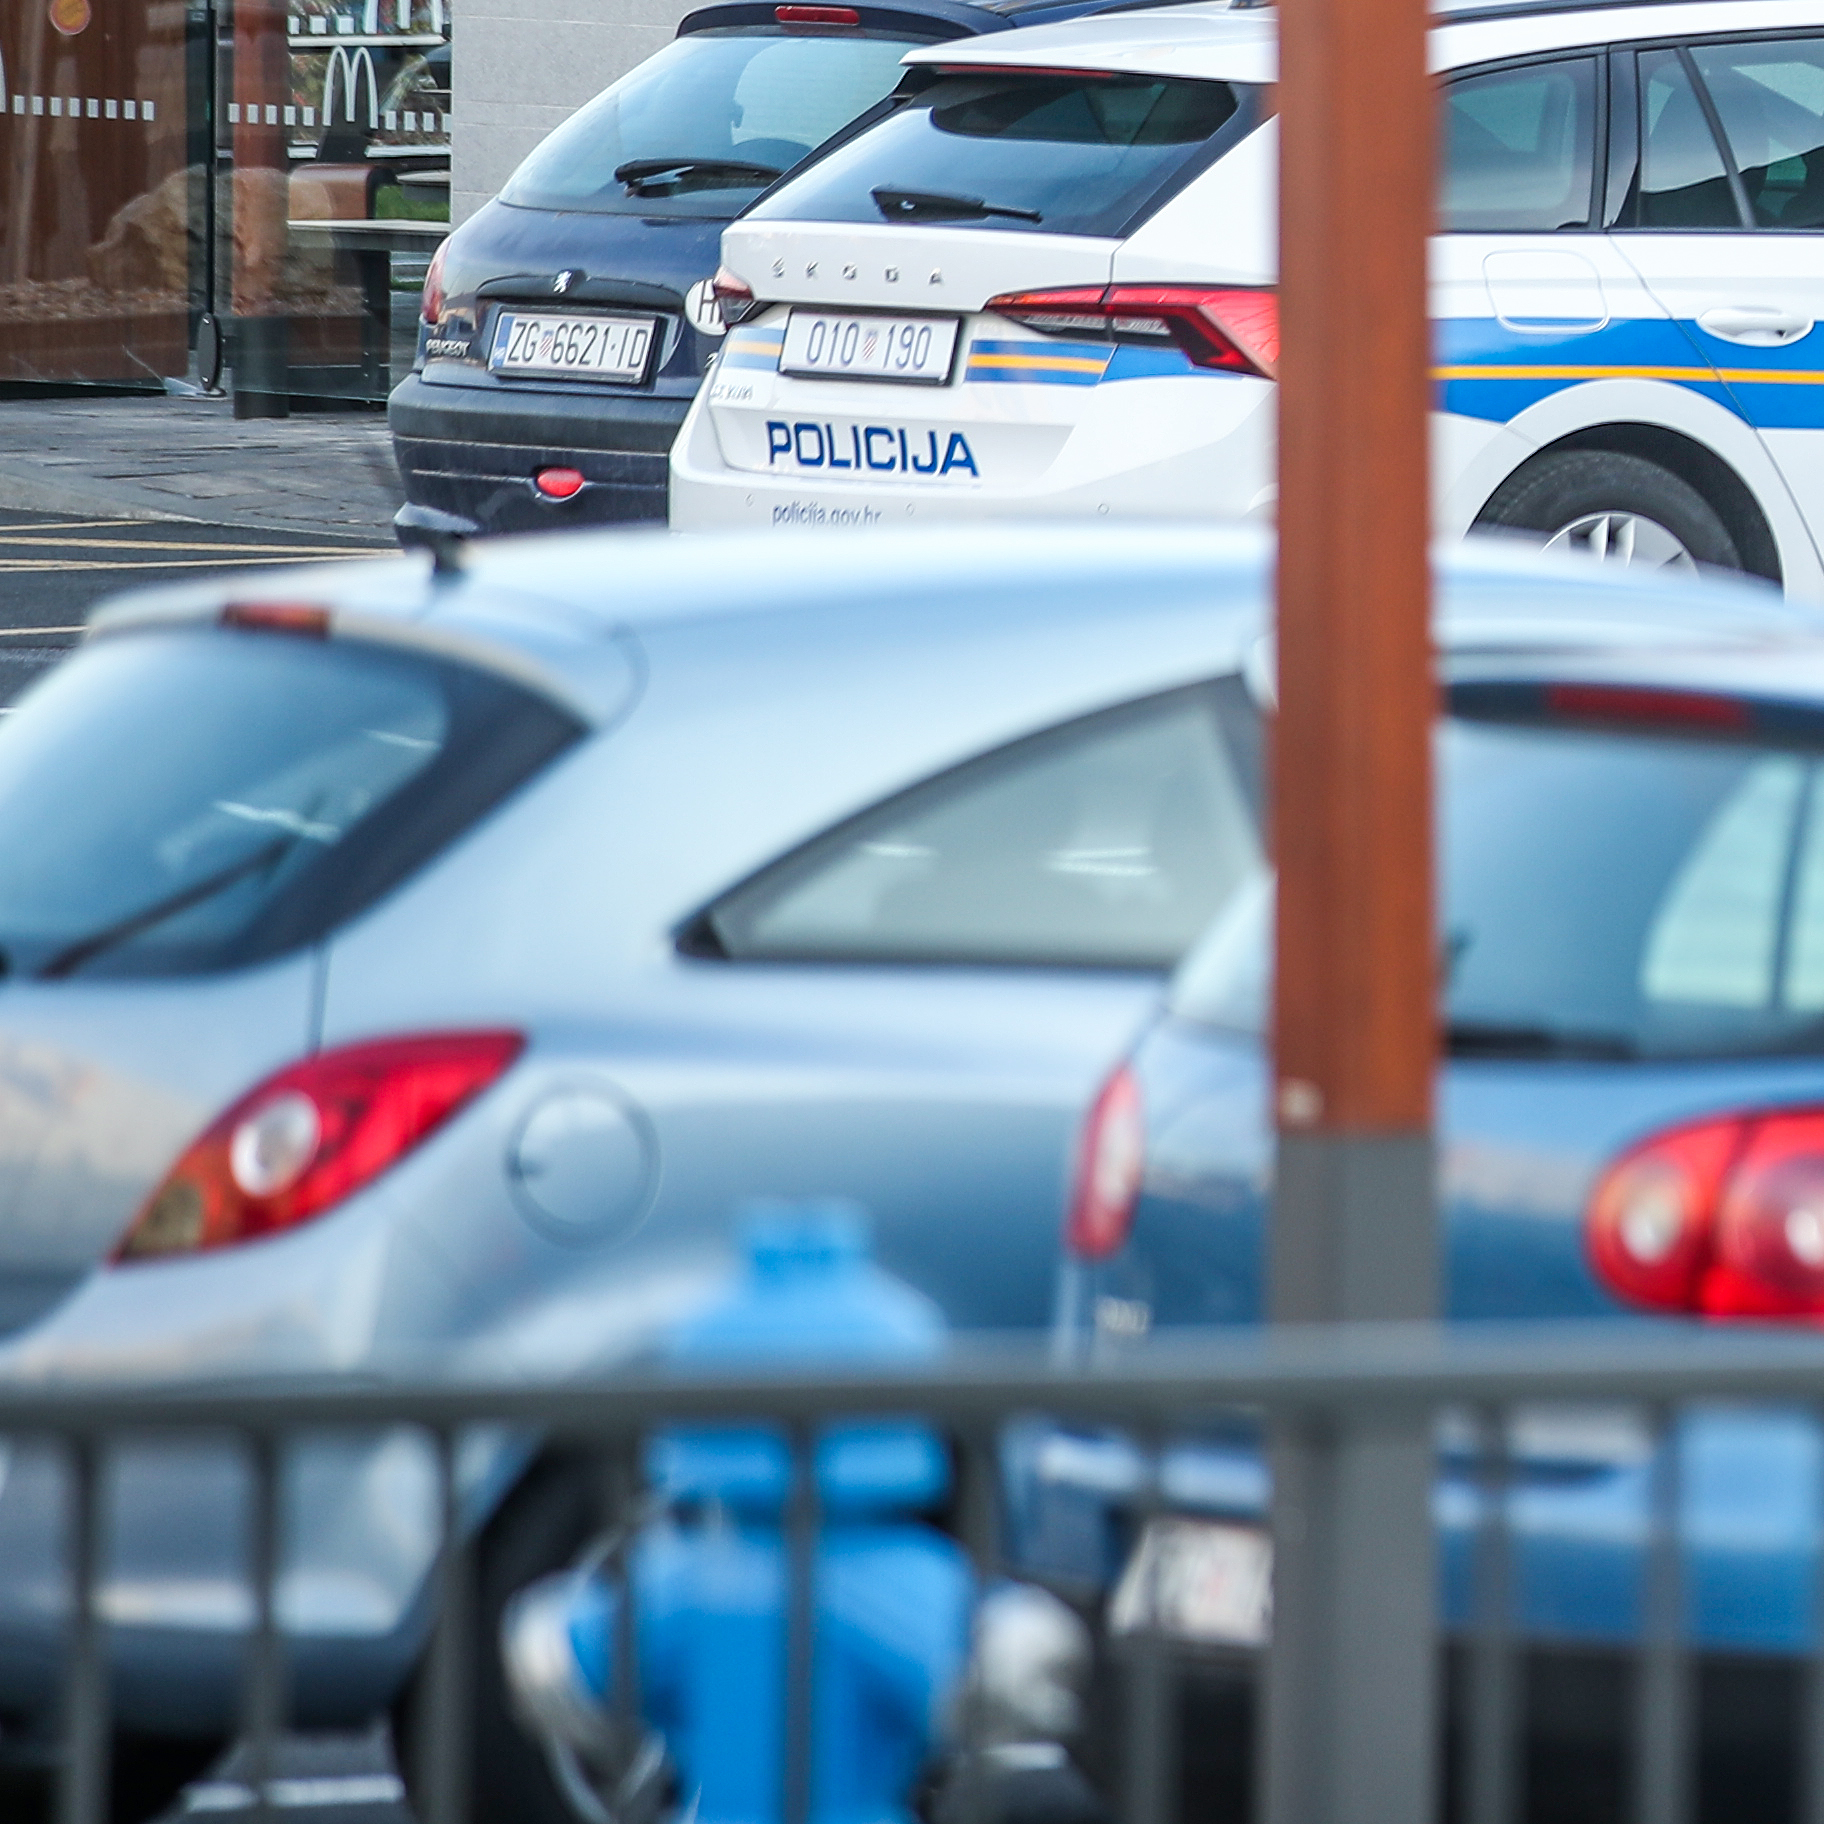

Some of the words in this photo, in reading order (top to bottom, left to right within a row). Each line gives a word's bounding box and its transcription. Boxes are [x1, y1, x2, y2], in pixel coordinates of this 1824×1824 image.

[508, 321, 541, 368] ZG
[806, 320, 859, 367] 010
[883, 324, 933, 370] 190
[766, 421, 981, 478] POLICIJA
[772, 501, 883, 527] policija.gov.hr
